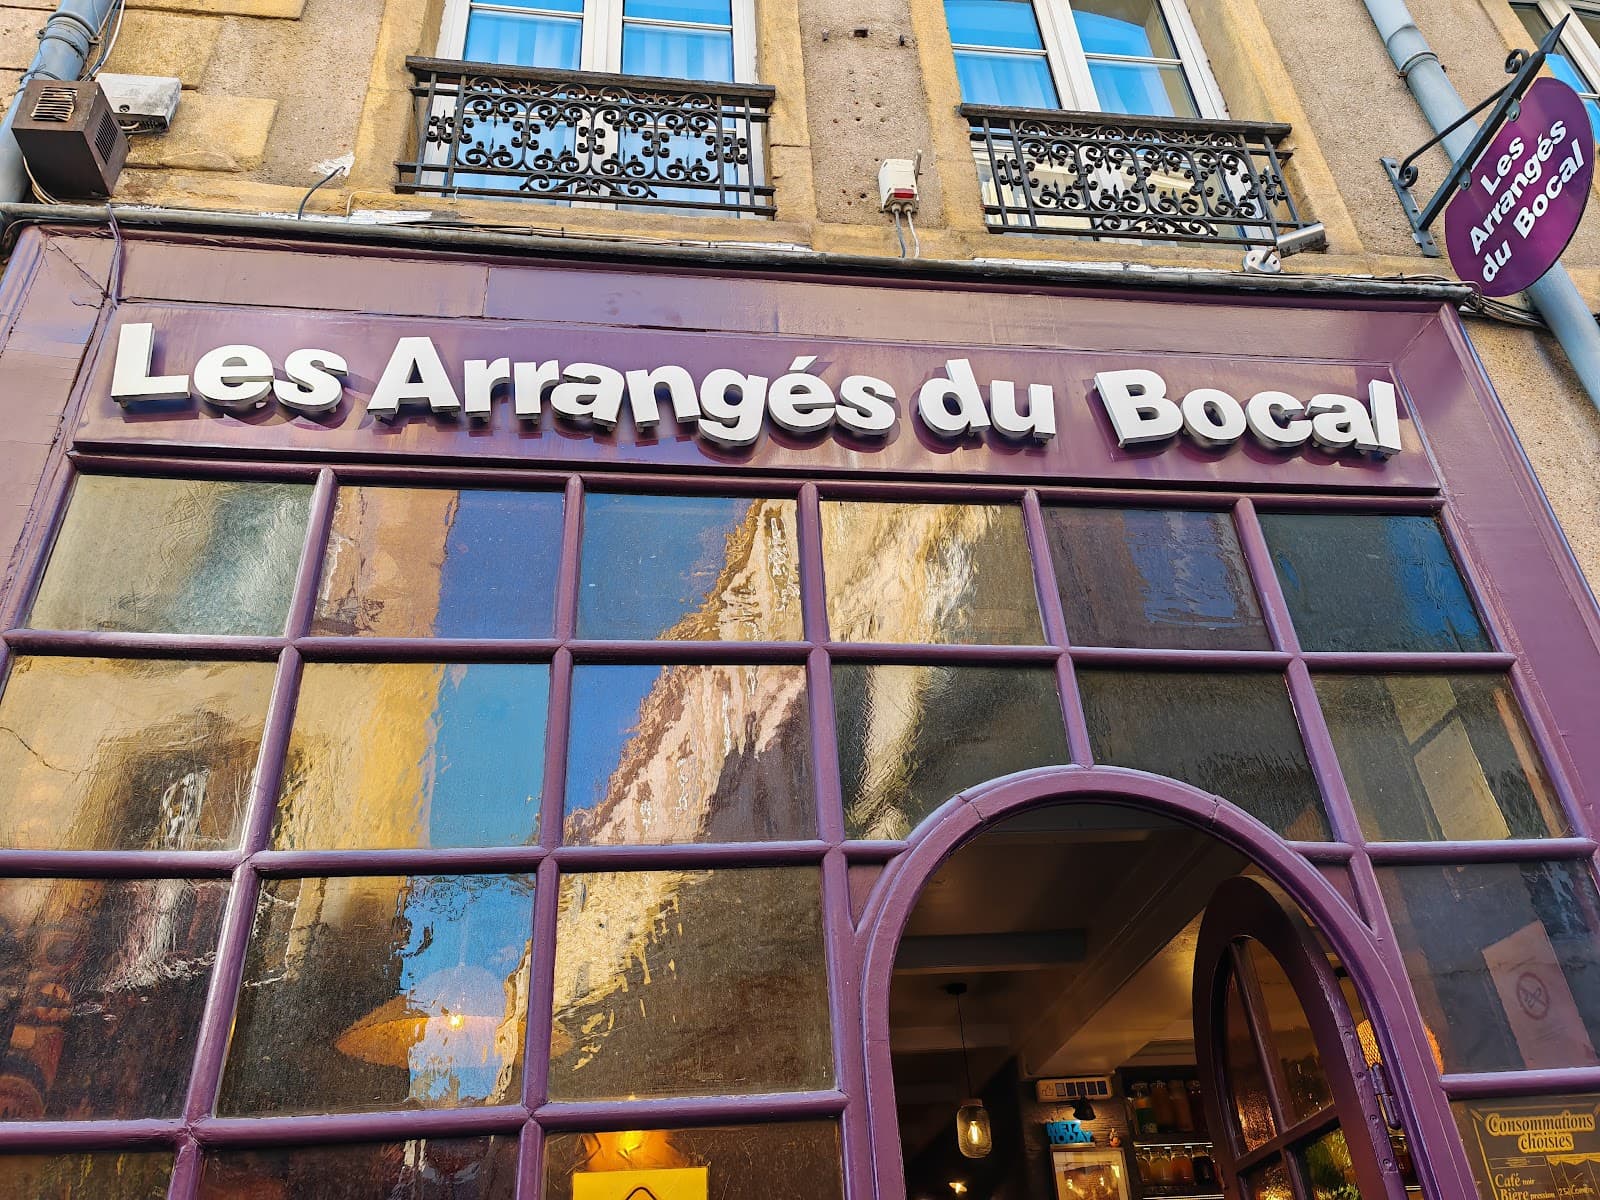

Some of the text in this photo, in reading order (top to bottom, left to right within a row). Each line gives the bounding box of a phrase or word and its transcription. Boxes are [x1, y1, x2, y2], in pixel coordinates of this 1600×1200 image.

[1480, 136, 1525, 196] Les
[1469, 120, 1567, 255] Arrangés
[1482, 138, 1585, 283] du Bocal
[111, 322, 1402, 455] Les Arrangés du Bocal
[1487, 1111, 1594, 1133] Consommations
[1049, 1131, 1093, 1144] TODAY
[1520, 1132, 1573, 1150] choisies
[1494, 1171, 1521, 1188] Café
[1499, 1187, 1529, 1200] Bière
